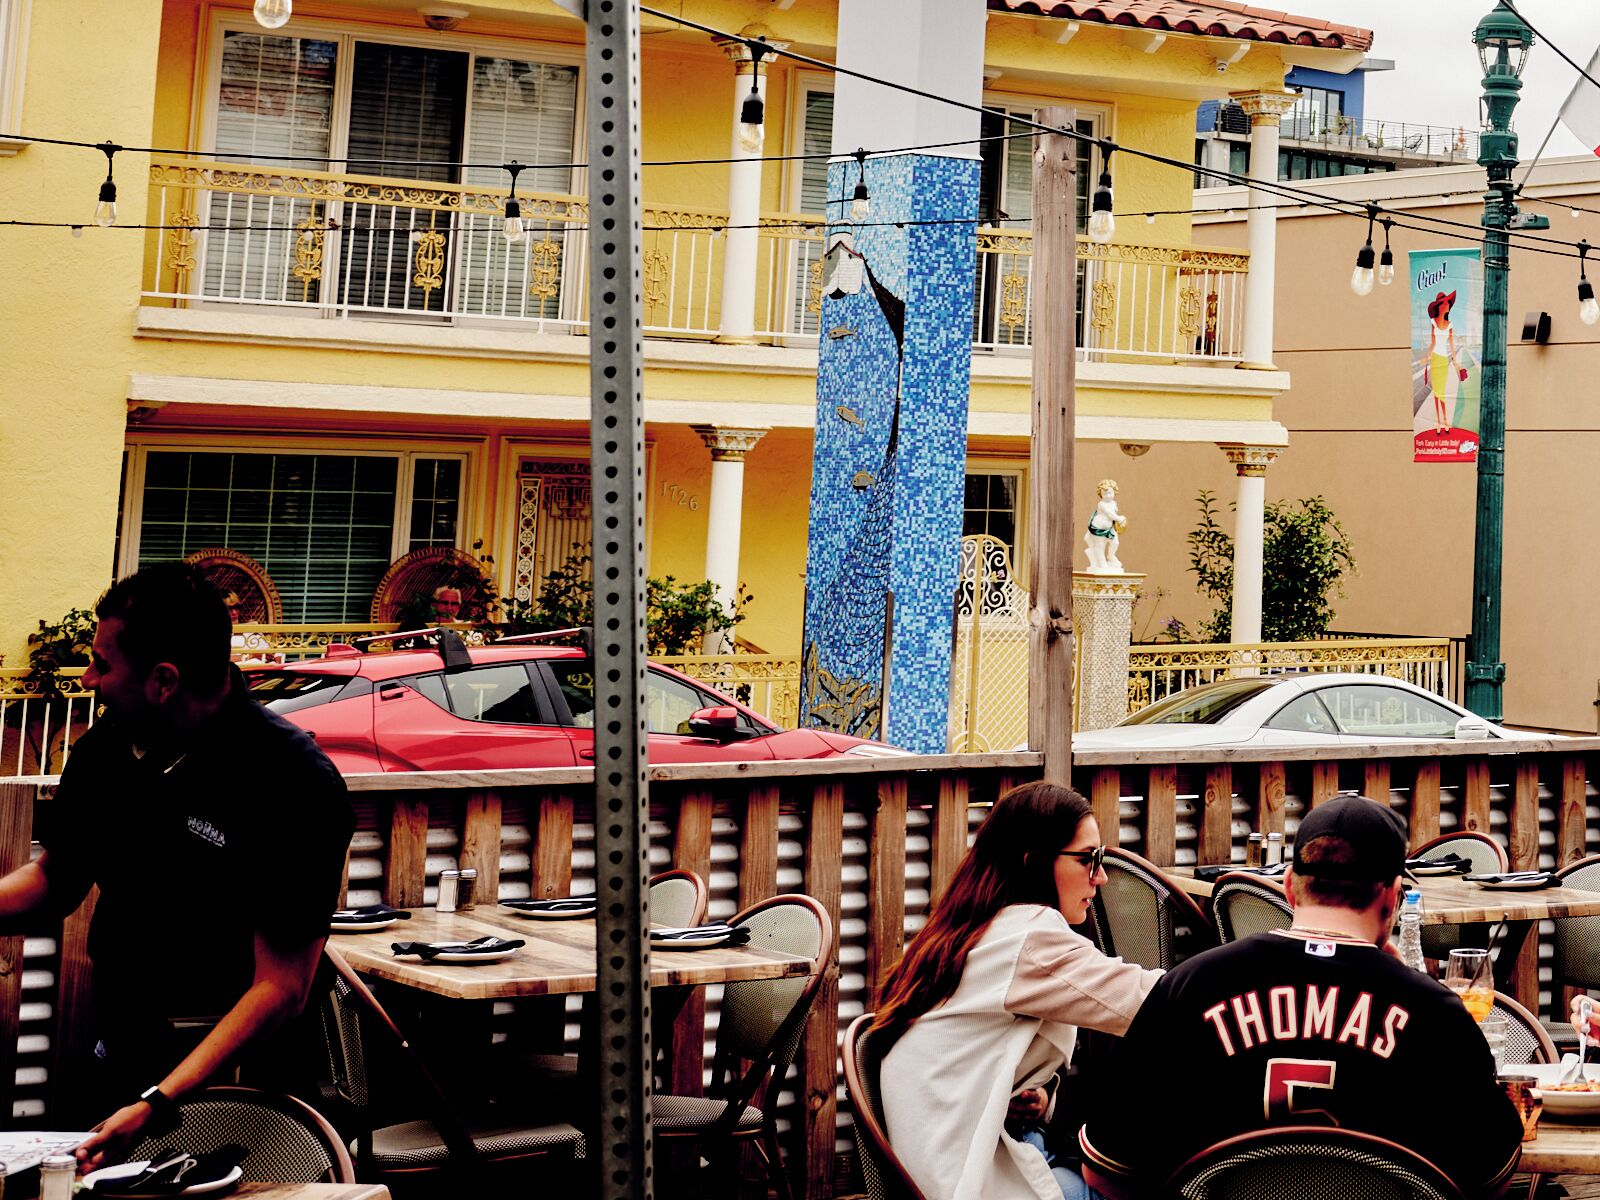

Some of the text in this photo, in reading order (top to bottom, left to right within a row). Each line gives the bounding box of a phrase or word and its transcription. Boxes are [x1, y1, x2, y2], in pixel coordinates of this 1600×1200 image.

[1417, 261, 1447, 291] Ciao!
[661, 481, 699, 511] 1726
[1203, 984, 1410, 1059] THOMAS
